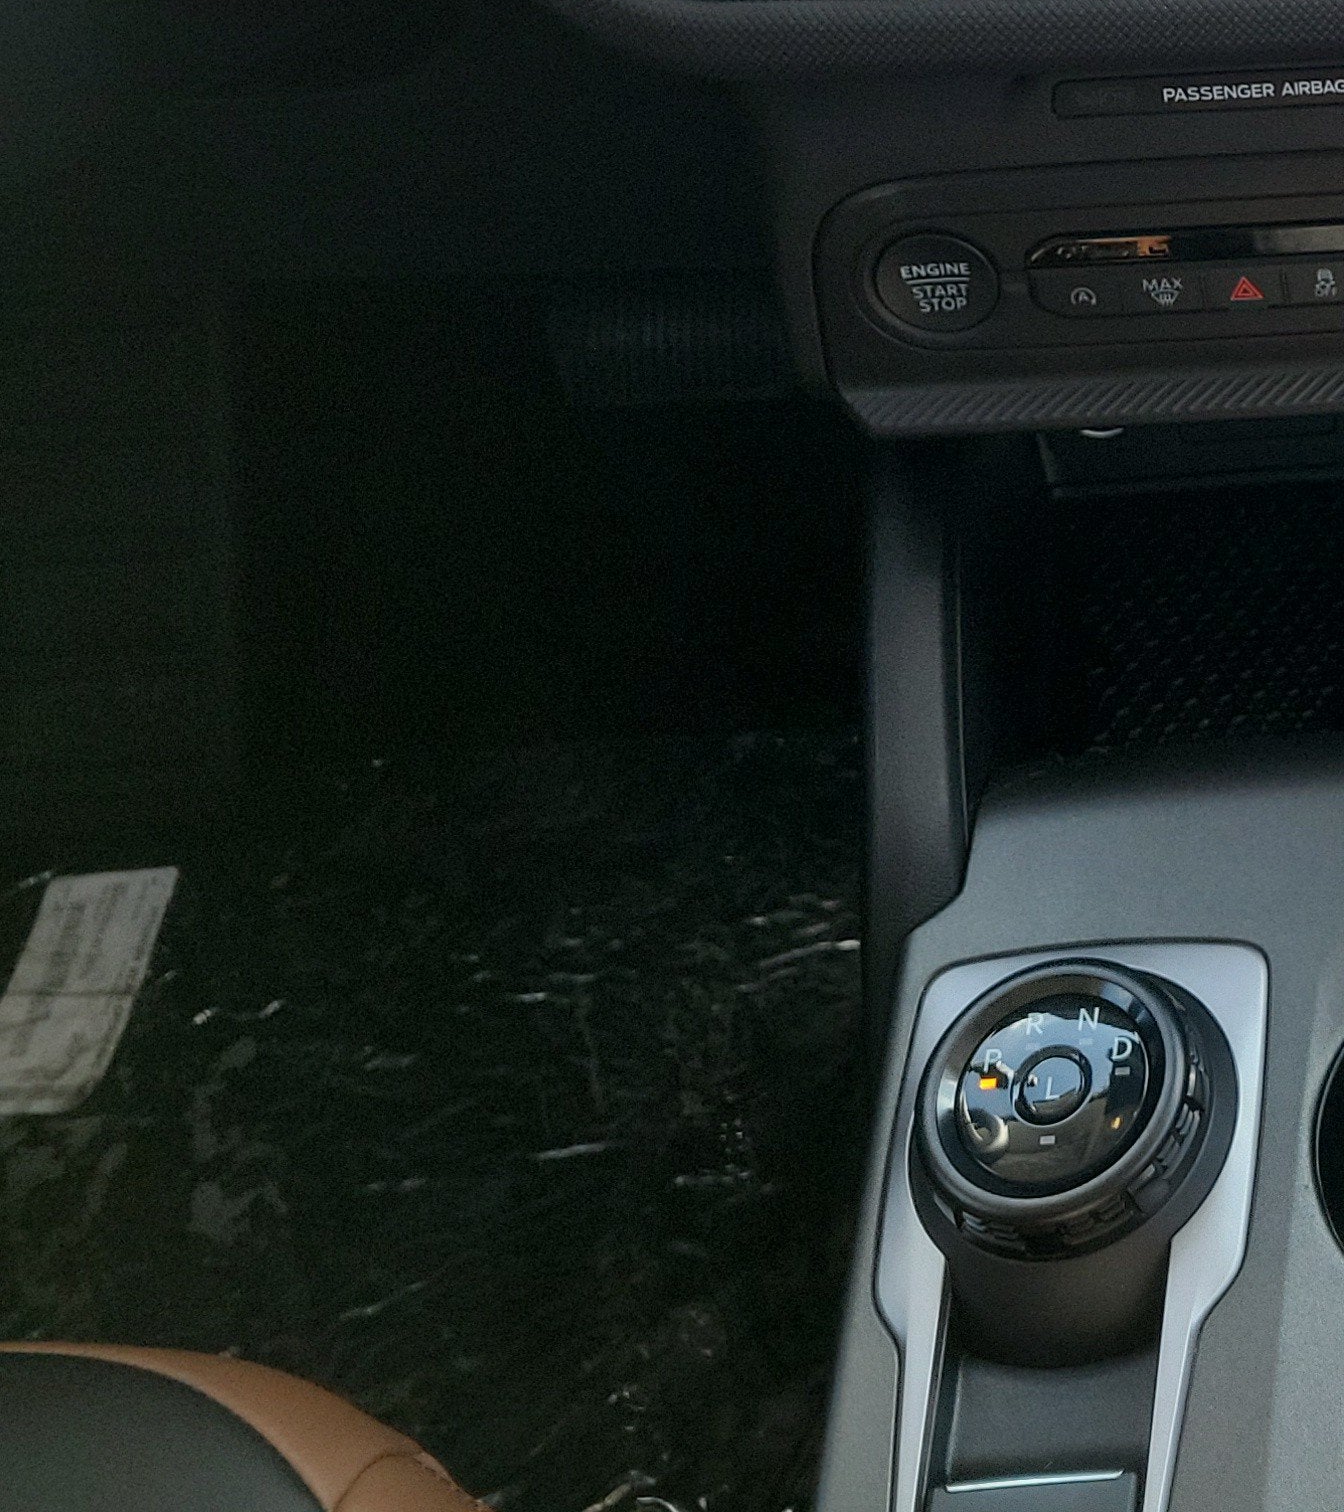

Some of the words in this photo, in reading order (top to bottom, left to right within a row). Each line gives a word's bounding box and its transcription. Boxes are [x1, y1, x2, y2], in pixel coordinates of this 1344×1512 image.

[1162, 83, 1275, 104] PASSENGER
[900, 262, 971, 279] ENGINE
[912, 283, 969, 299] START
[1142, 277, 1184, 293] MAX
[919, 296, 967, 313] STOP
[1025, 1012, 1044, 1036] R
[1077, 1006, 1100, 1031] N
[1111, 1036, 1133, 1060] D
[984, 1048, 1002, 1073] P
[1045, 1076, 1061, 1100] L
